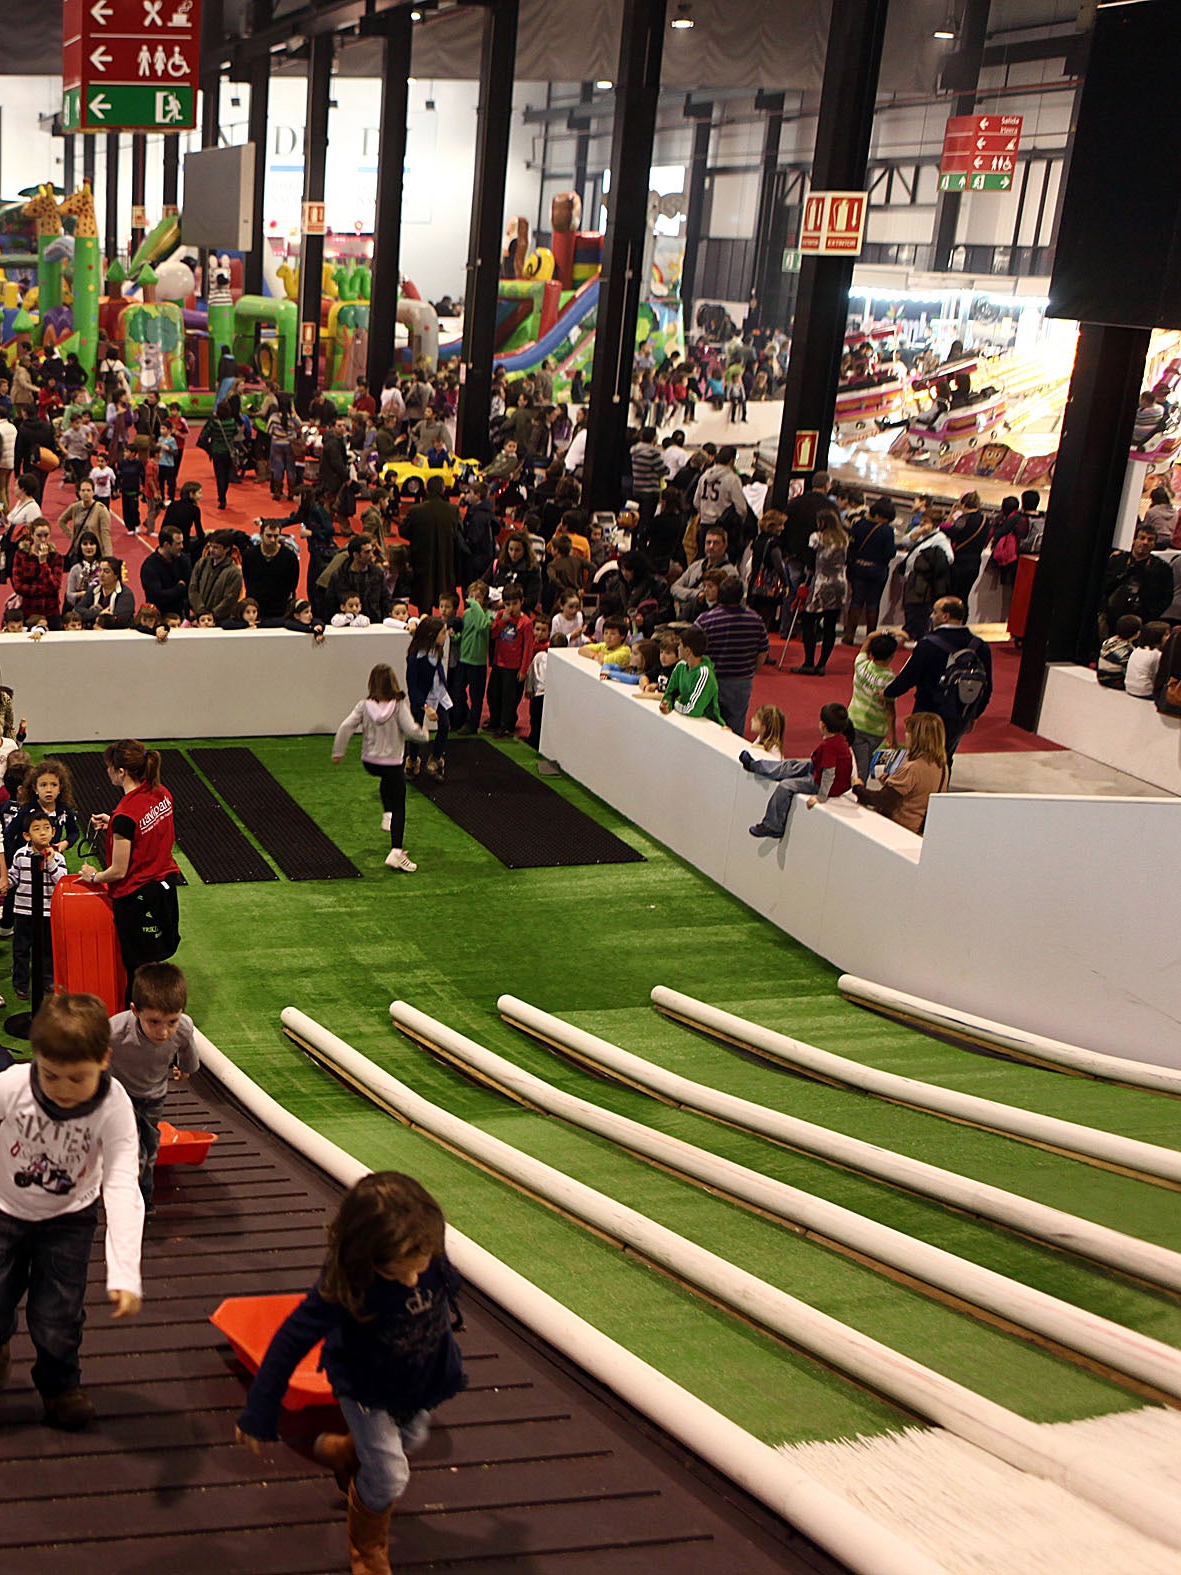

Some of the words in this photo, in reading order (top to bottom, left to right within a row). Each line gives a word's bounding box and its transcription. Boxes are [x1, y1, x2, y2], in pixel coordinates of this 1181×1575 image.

[701, 478, 722, 502] 15
[139, 795, 172, 828] navipark
[15, 1111, 92, 1154] SIXTIES
